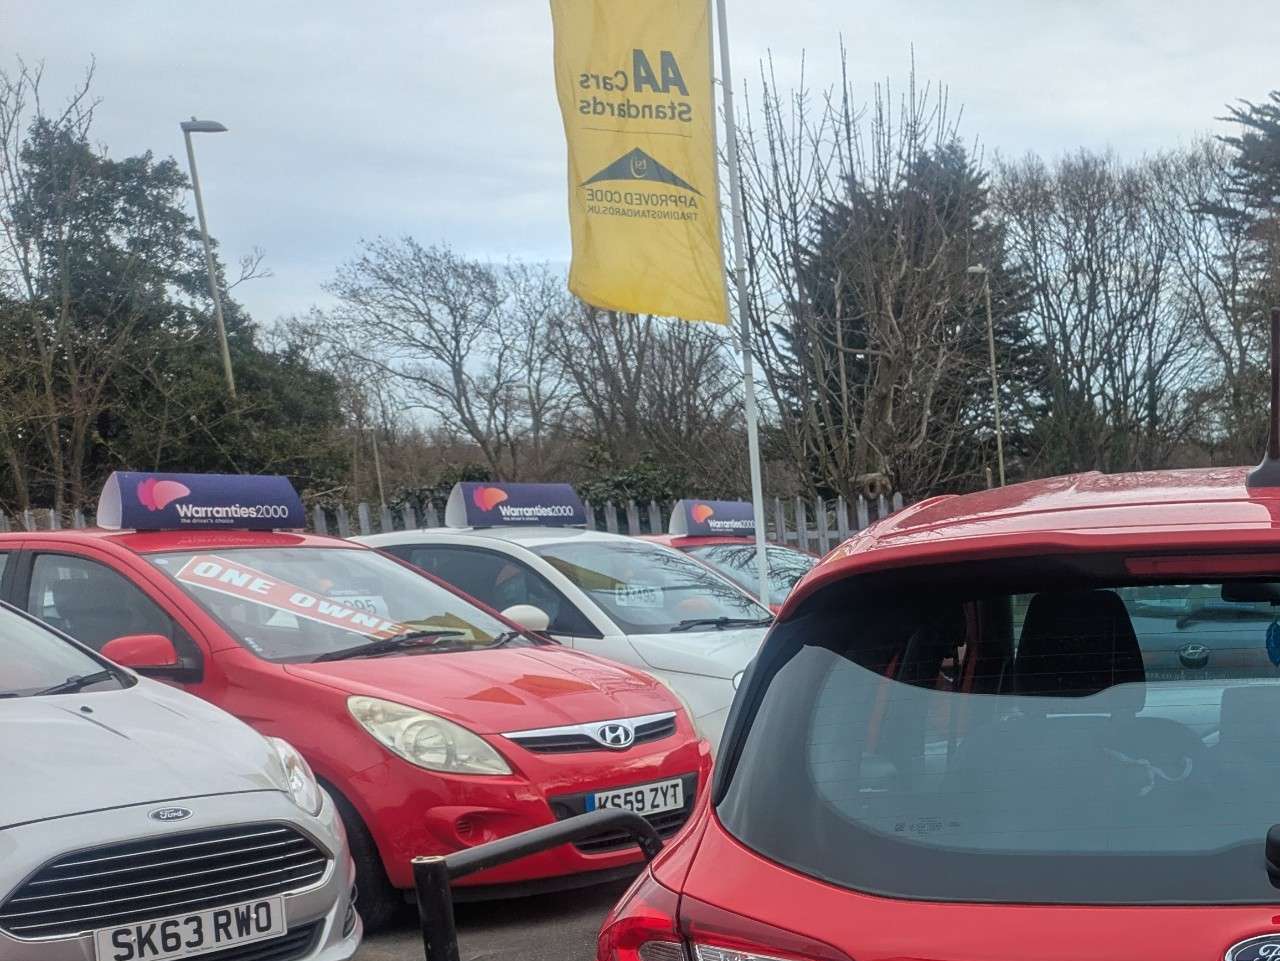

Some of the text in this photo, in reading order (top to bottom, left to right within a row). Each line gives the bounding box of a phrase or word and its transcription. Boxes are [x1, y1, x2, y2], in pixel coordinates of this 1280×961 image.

[175, 503, 289, 519] Warranties2000
[498, 504, 574, 517] Warranties2000
[192, 561, 276, 595] ONE
[649, 783, 680, 809] ZYT
[111, 901, 272, 961] SK63 RWO
